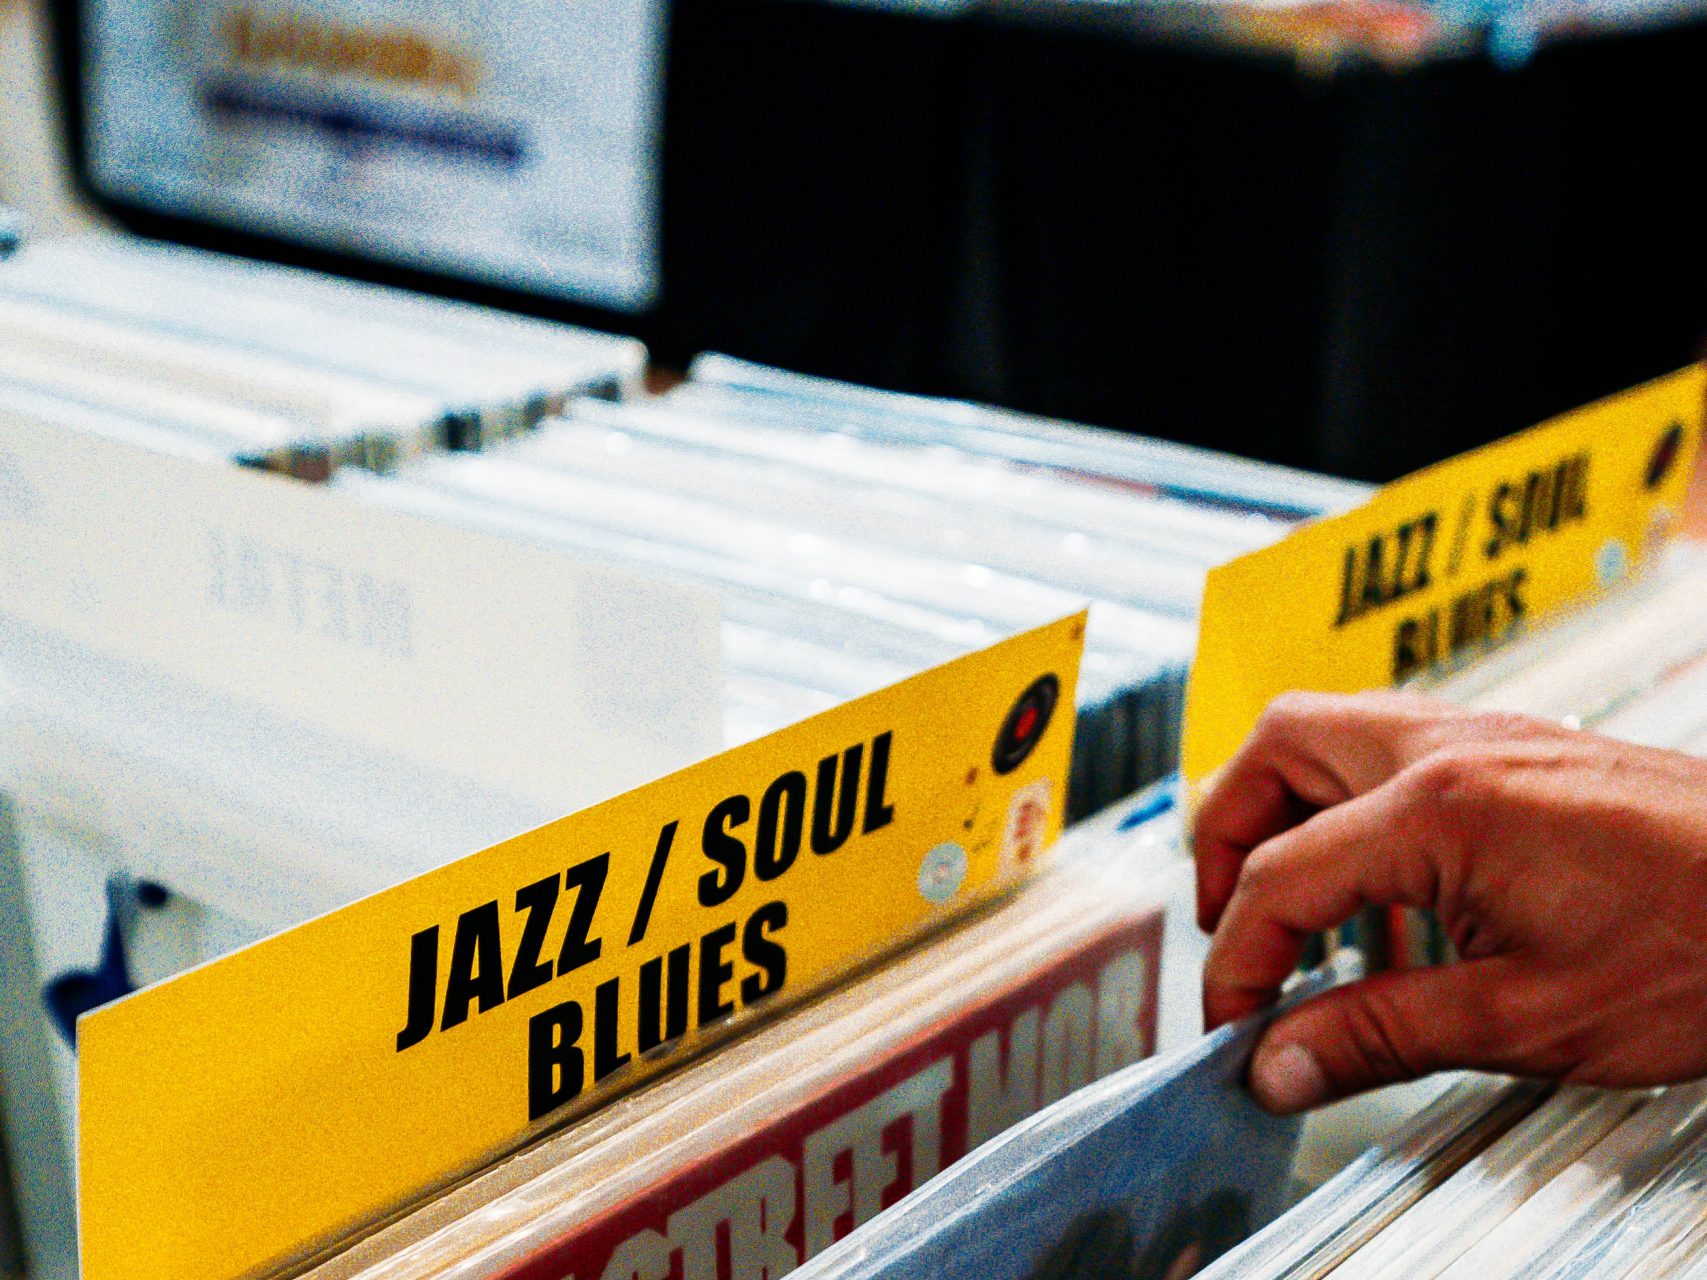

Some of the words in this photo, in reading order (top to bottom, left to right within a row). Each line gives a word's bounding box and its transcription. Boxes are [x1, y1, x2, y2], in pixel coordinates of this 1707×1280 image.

[1334, 510, 1440, 629] JAZZ
[1446, 494, 1476, 577] /
[1484, 449, 1591, 560] SOUL
[1391, 567, 1528, 688] BLUES
[396, 851, 610, 1053] JAZZ
[627, 820, 679, 947] /
[697, 730, 893, 907] SOUL
[529, 901, 788, 1122] BLUES
